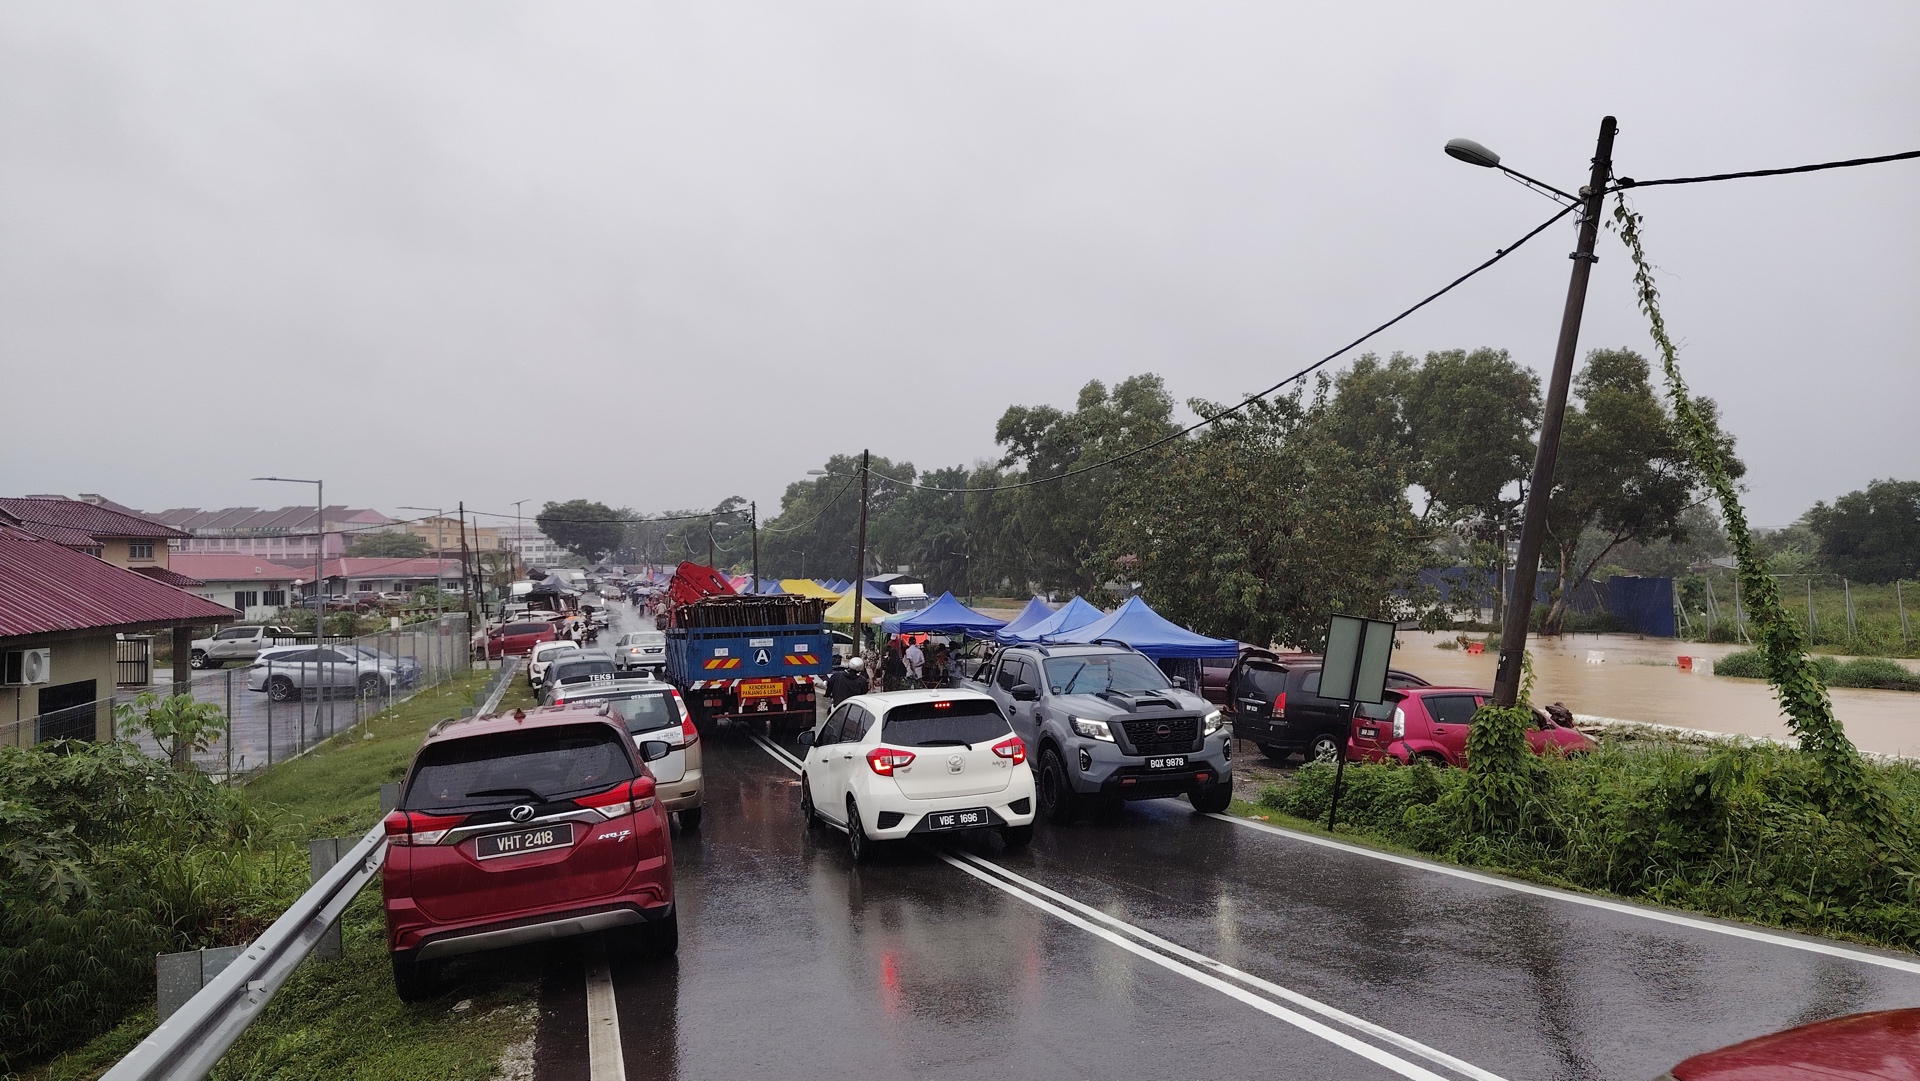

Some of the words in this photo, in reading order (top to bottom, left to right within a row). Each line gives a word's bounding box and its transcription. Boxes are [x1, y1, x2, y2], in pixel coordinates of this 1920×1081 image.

[756, 649, 769, 663] A
[588, 673, 615, 681] TEKSI
[1150, 759, 1164, 768] BQX
[1166, 758, 1184, 767] 9878
[939, 815, 955, 826] VBE
[960, 813, 978, 824] 1696
[496, 835, 522, 851] VHT
[524, 830, 554, 848] 2418
